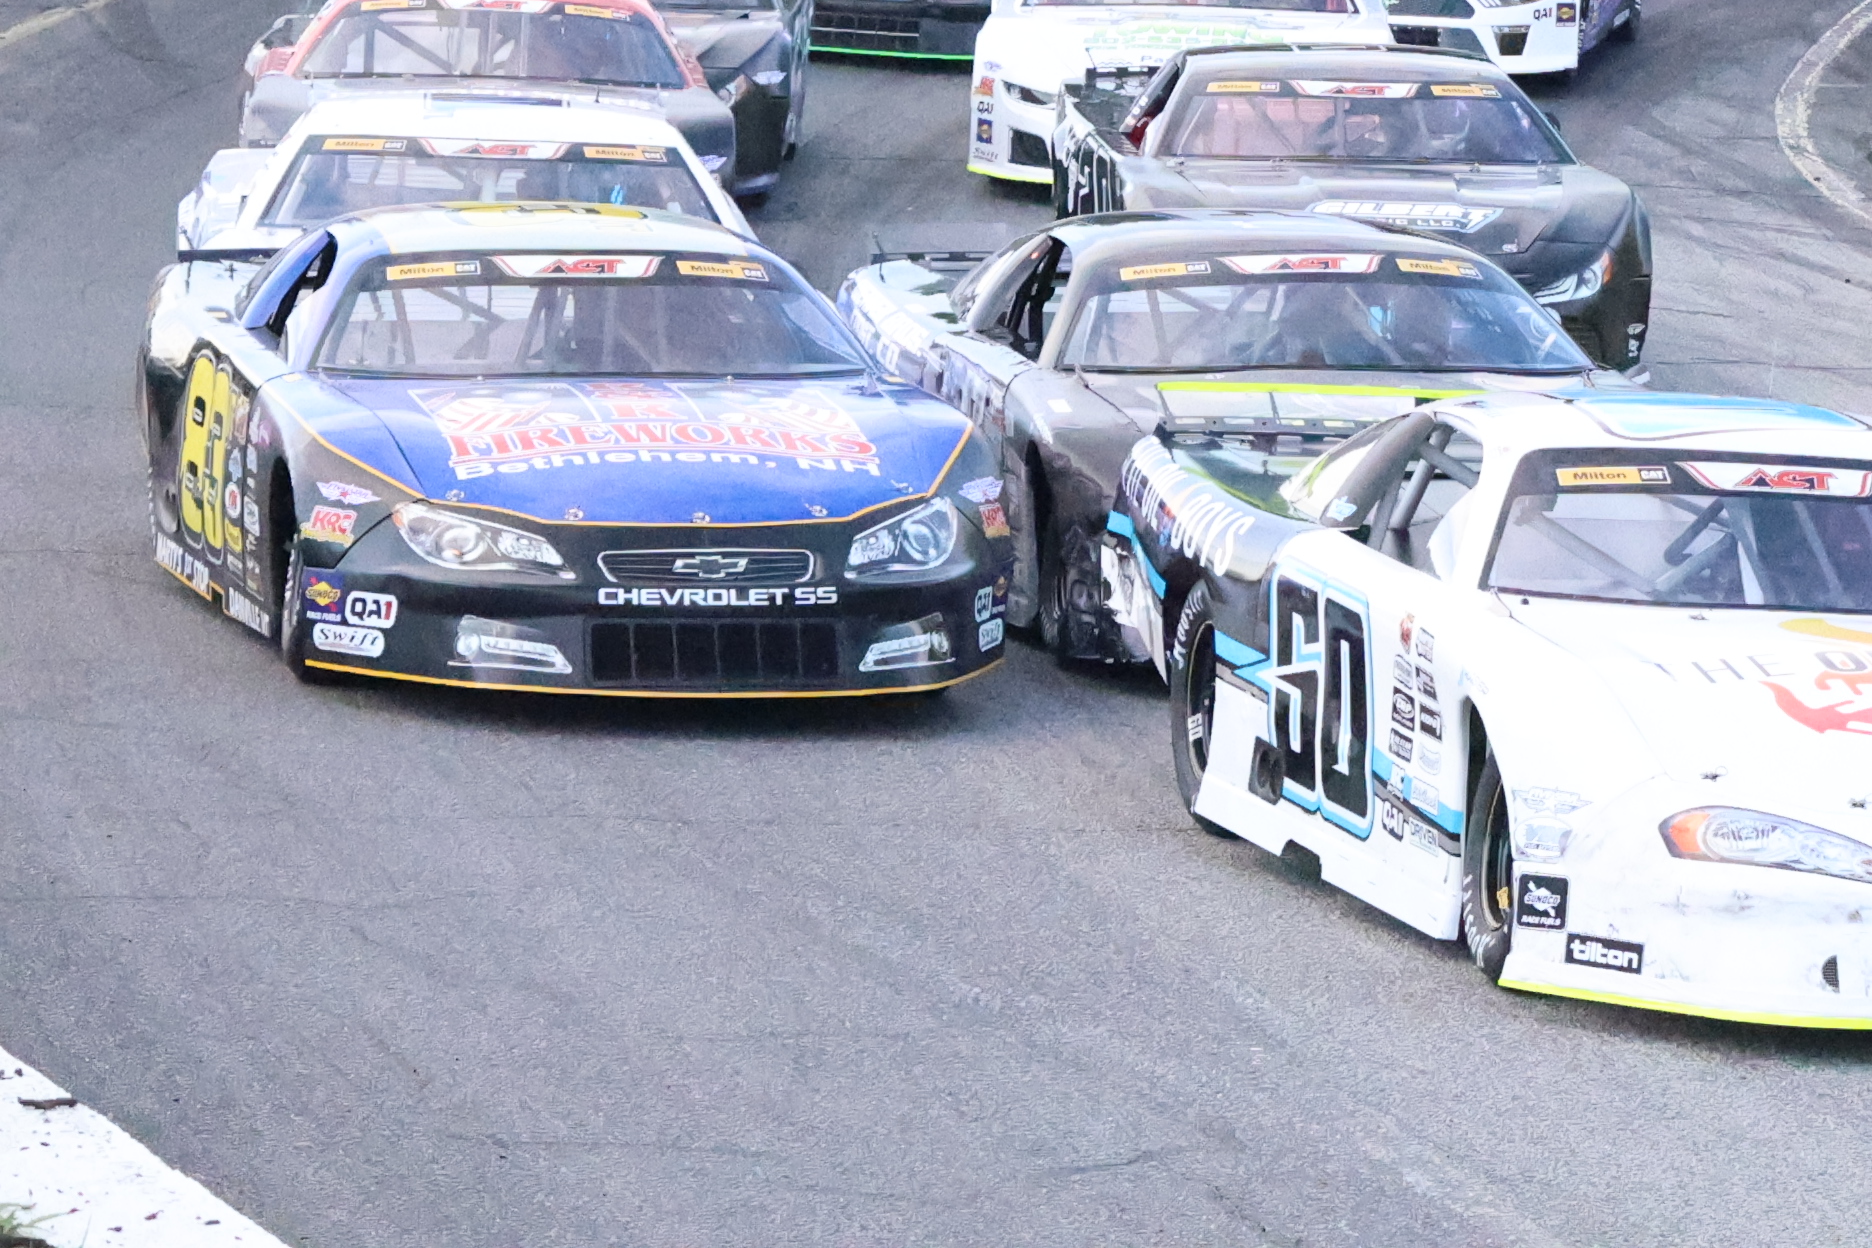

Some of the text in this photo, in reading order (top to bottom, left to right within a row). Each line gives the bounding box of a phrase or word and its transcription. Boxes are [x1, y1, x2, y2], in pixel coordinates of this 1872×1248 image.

[1533, 7, 1553, 21] QA1
[1312, 203, 1496, 223] GILBERT
[399, 265, 446, 276] Milton
[533, 258, 628, 275] ACT
[690, 264, 735, 275] Milton
[1133, 266, 1177, 276] Milton
[1261, 256, 1348, 271] ACT
[1409, 262, 1450, 273] Milton
[448, 422, 877, 459] FIREWORKS
[454, 449, 881, 481] Bethlehem, NH
[1572, 468, 1669, 482] Milton CAT
[1733, 466, 1840, 492] ACT
[311, 510, 353, 534] KRC
[1170, 492, 1256, 577] BOYS
[305, 587, 342, 602] SUNOCO
[598, 587, 838, 607] CHEVROLET SS
[350, 597, 393, 622] QA1
[317, 627, 381, 647] Swift
[1652, 651, 1797, 685] THE
[1525, 893, 1561, 906] SUNOCO
[1520, 915, 1561, 926] RACE FUELS
[1569, 939, 1639, 969] tilton
